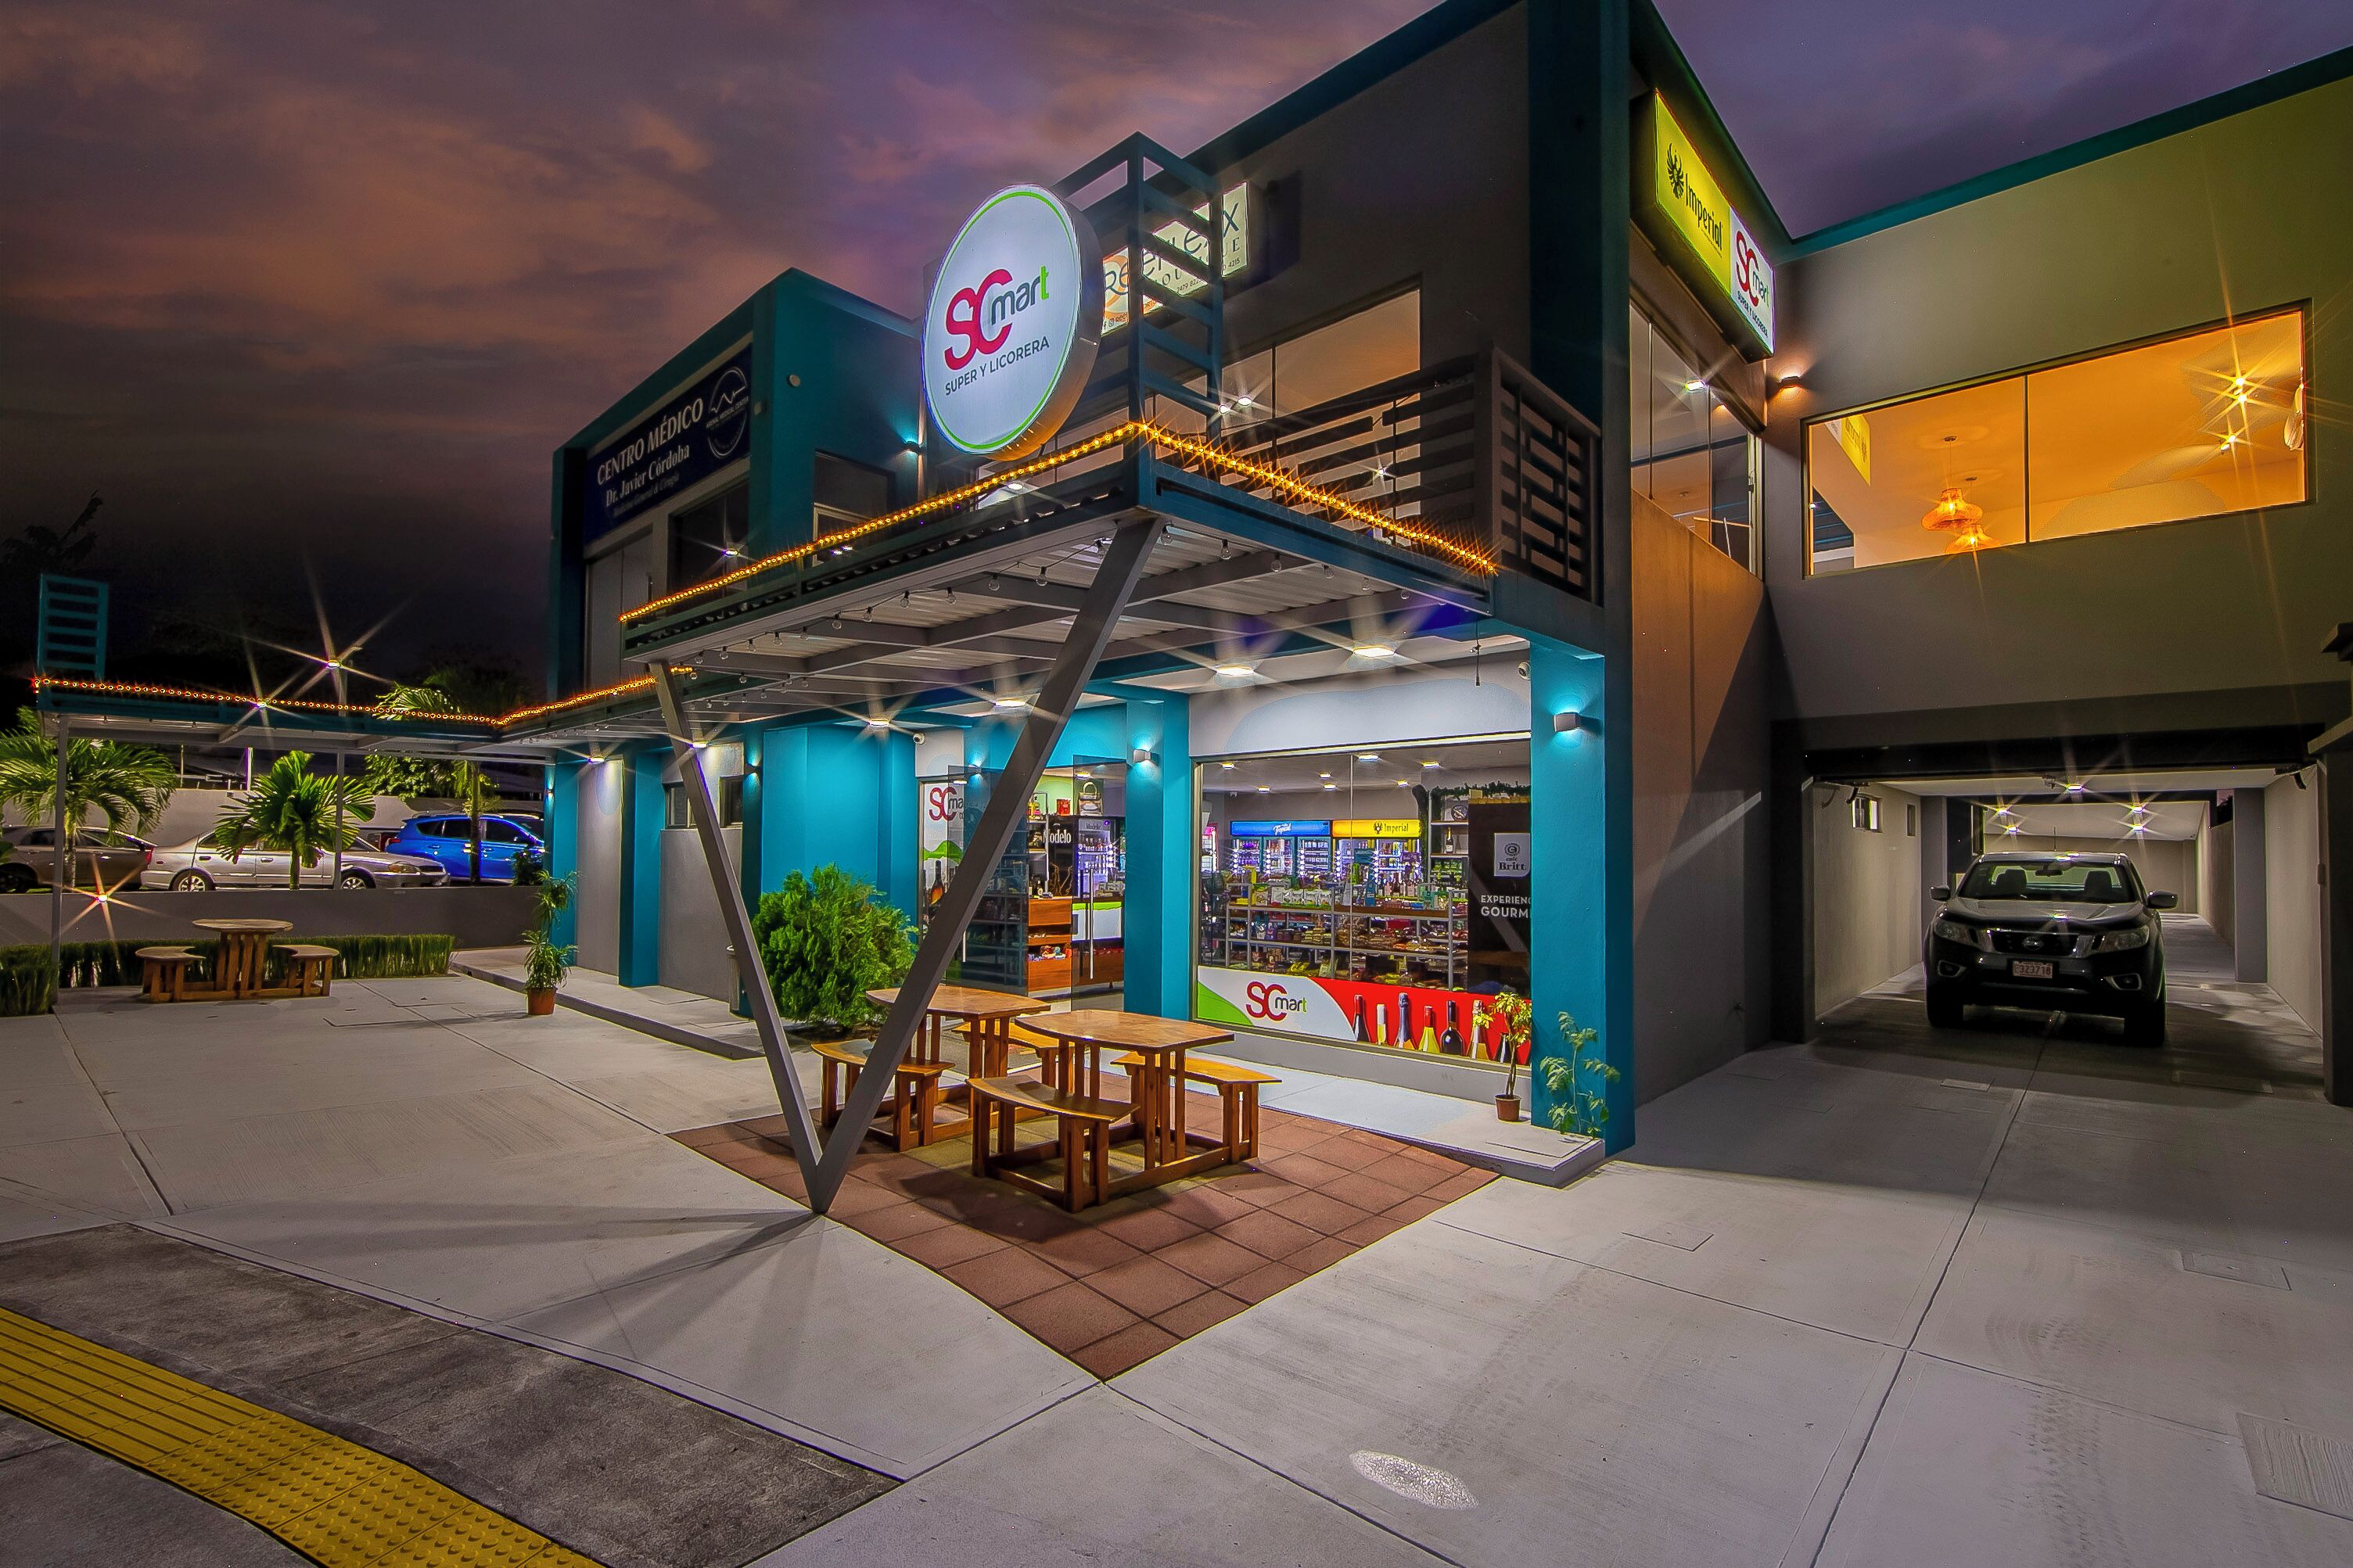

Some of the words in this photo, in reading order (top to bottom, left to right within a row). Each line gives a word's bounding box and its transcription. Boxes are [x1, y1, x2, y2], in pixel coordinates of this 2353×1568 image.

[1685, 173, 1723, 251] Imperial
[944, 265, 1050, 371] SCmart
[945, 368, 978, 396] SUPER
[979, 363, 987, 377] Y
[990, 335, 1050, 374] LICORERA
[597, 438, 645, 486] CENTRO
[647, 397, 703, 454] MÉDICO
[606, 488, 618, 507] Dr.
[620, 472, 647, 499] Javier
[648, 444, 690, 480] Córdoba
[1384, 822, 1409, 834] Imperial
[1498, 861, 1527, 871] Britt
[1481, 906, 1532, 919] GOURM
[1245, 981, 1307, 1021] SCmart
